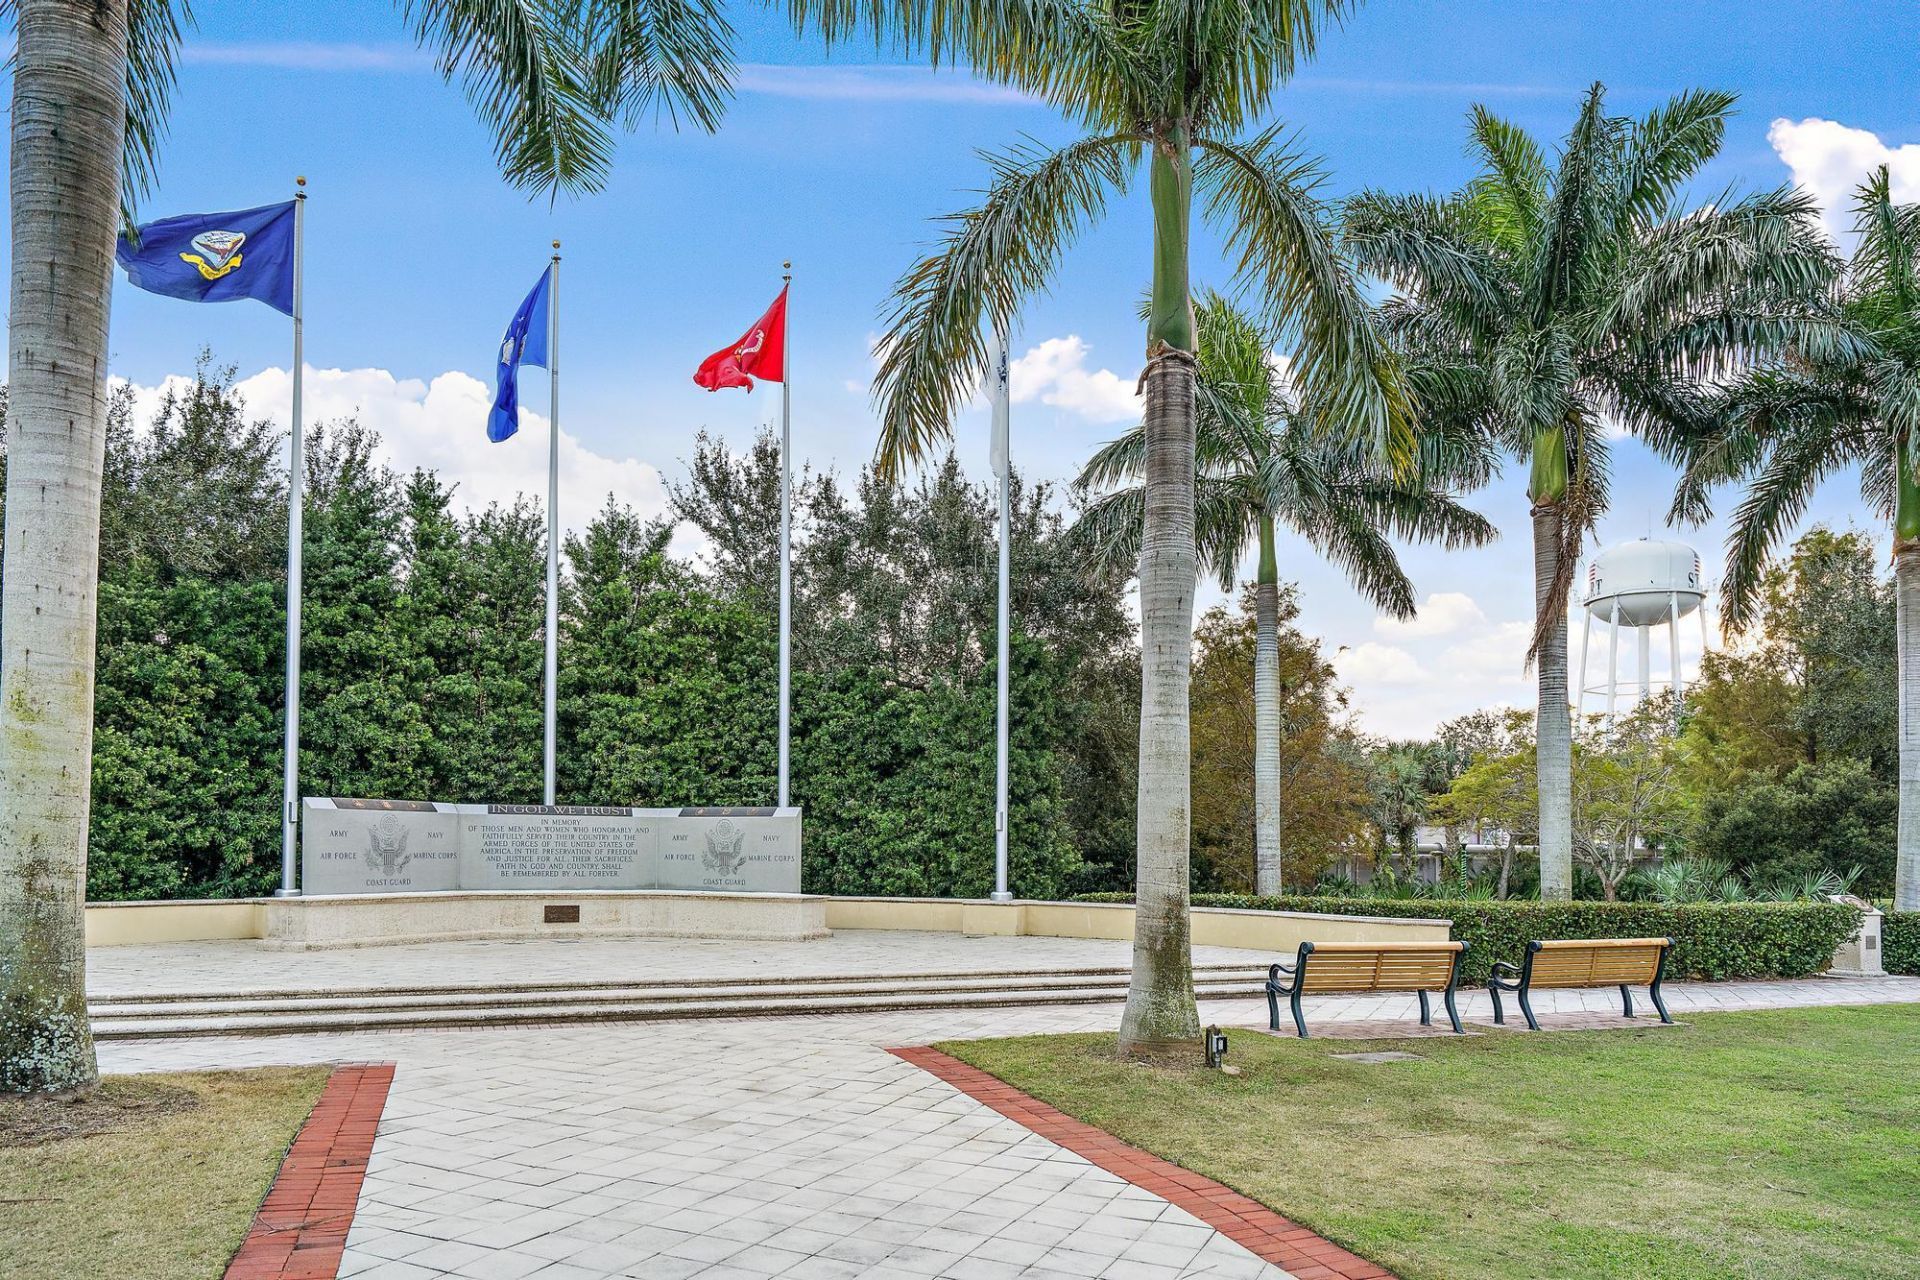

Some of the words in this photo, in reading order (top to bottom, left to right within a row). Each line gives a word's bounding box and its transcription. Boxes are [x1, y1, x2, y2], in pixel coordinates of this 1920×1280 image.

[492, 805, 508, 813] IN
[553, 806, 576, 814] WE
[583, 807, 629, 815] TRUST
[390, 878, 412, 886] GUARD
